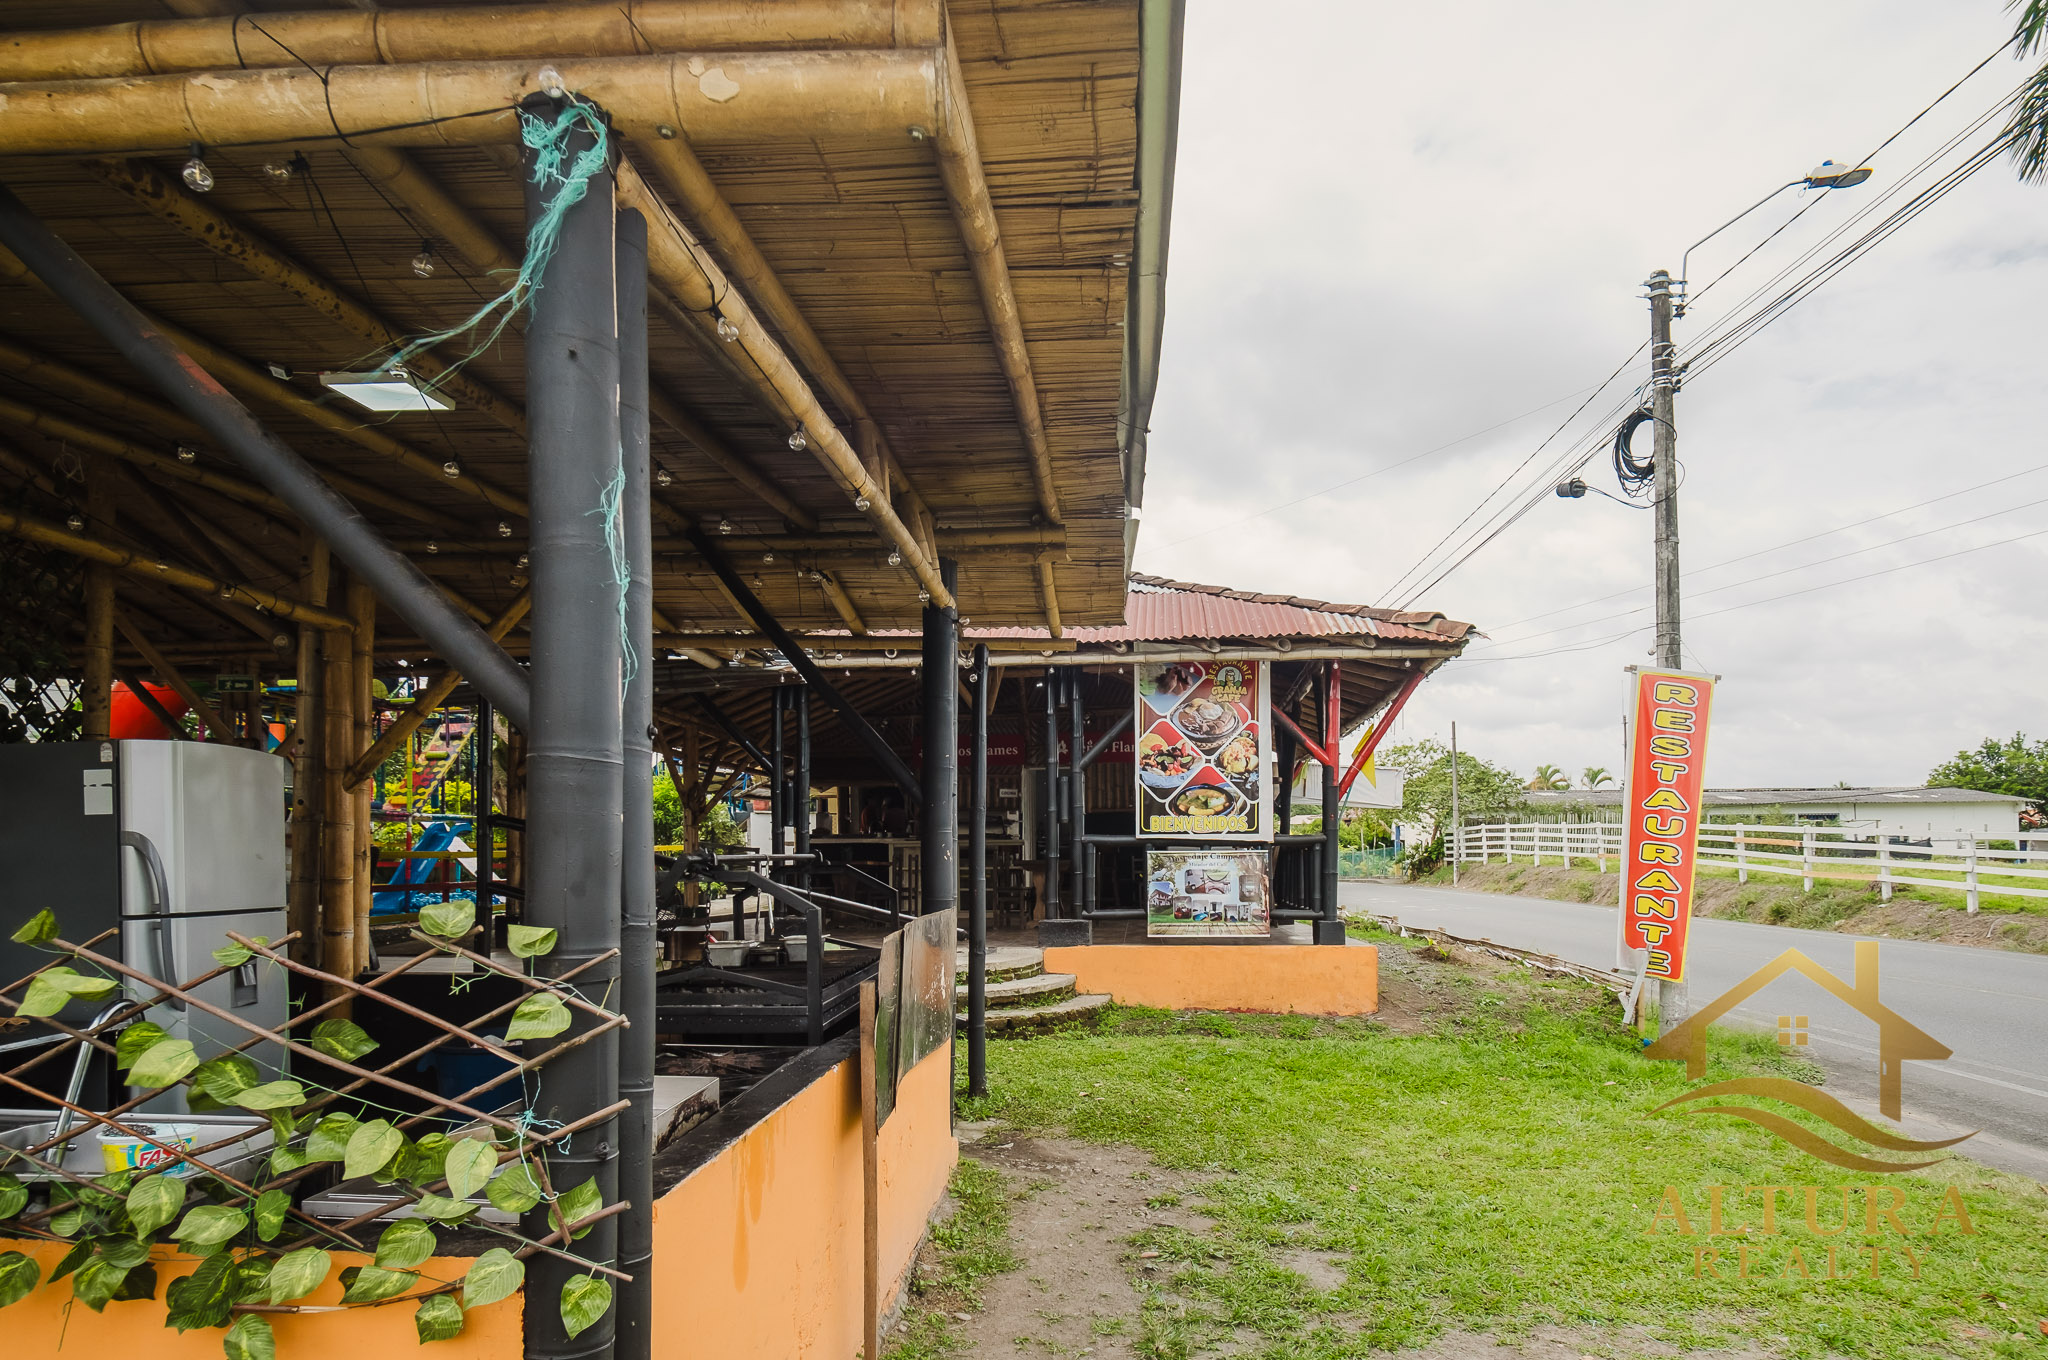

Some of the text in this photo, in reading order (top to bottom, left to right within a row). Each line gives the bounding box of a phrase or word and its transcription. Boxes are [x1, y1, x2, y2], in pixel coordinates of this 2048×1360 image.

[1207, 660, 1252, 680] RESTAURANTE
[1211, 685, 1248, 696] GRANJA
[1150, 815, 1248, 832] BIENVENIDOS
[1635, 681, 1698, 975] RESTAURANTE
